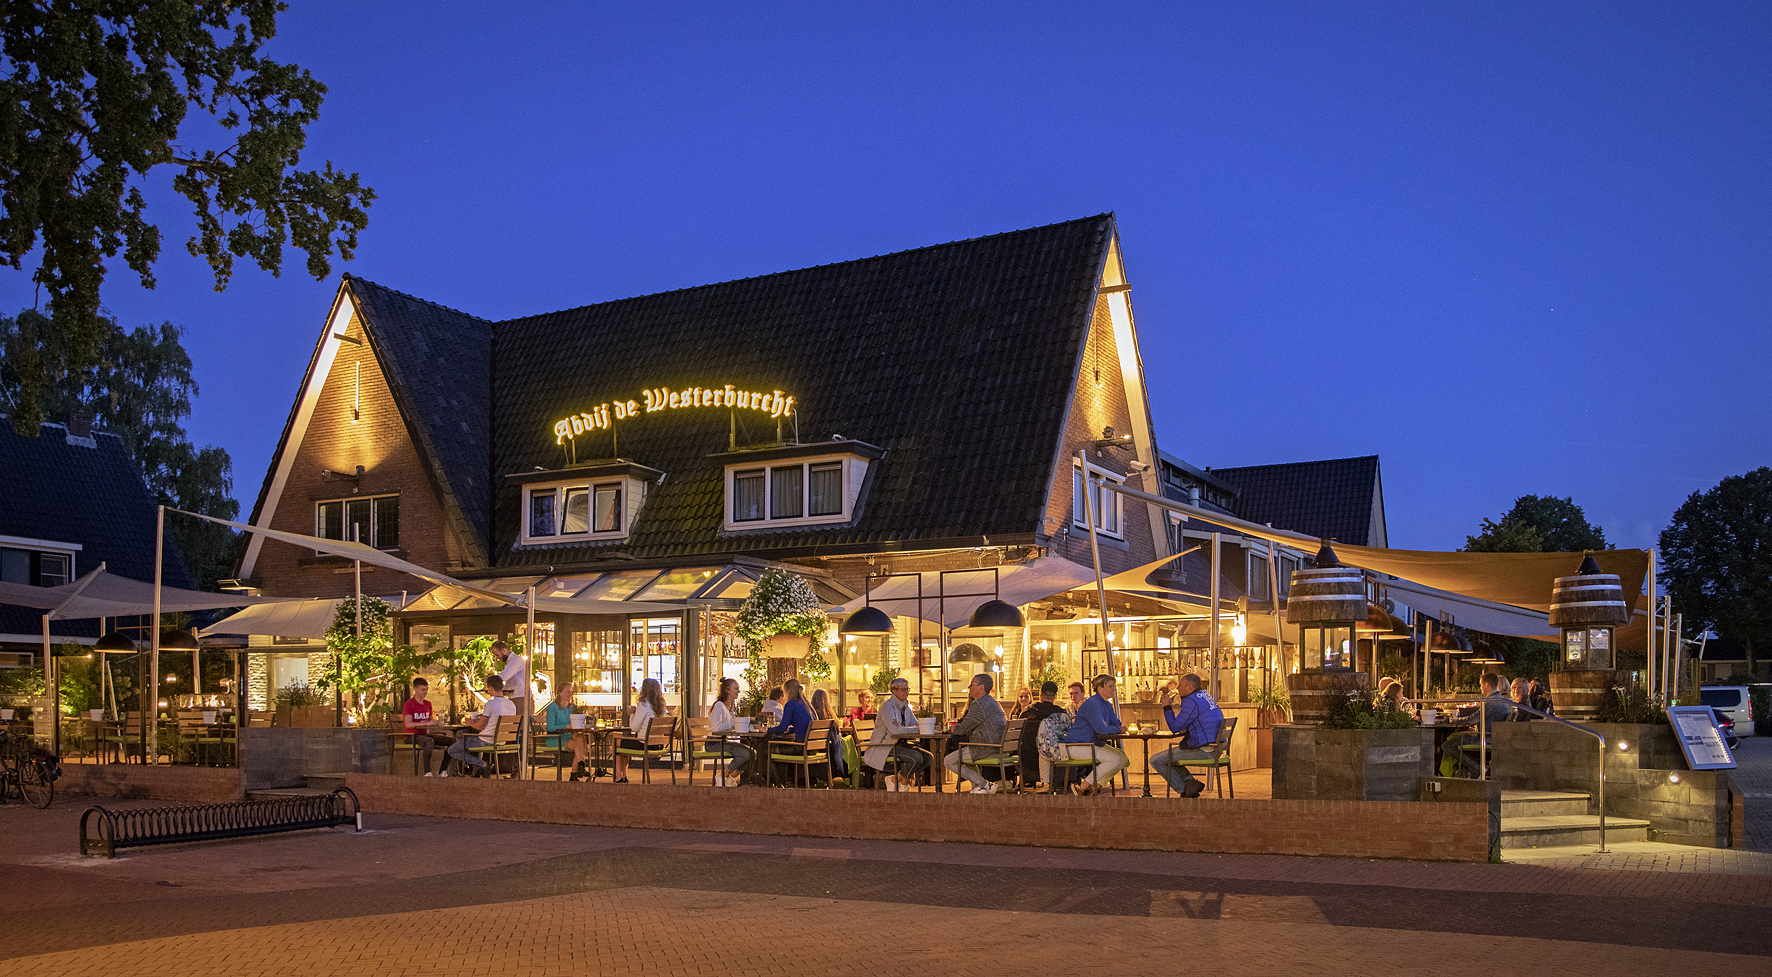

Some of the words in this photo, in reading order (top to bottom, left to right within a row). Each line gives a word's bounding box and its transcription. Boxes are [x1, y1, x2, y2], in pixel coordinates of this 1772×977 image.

[554, 403, 611, 445] Abdij
[613, 399, 639, 420] de
[643, 385, 797, 418] Westerburcht
